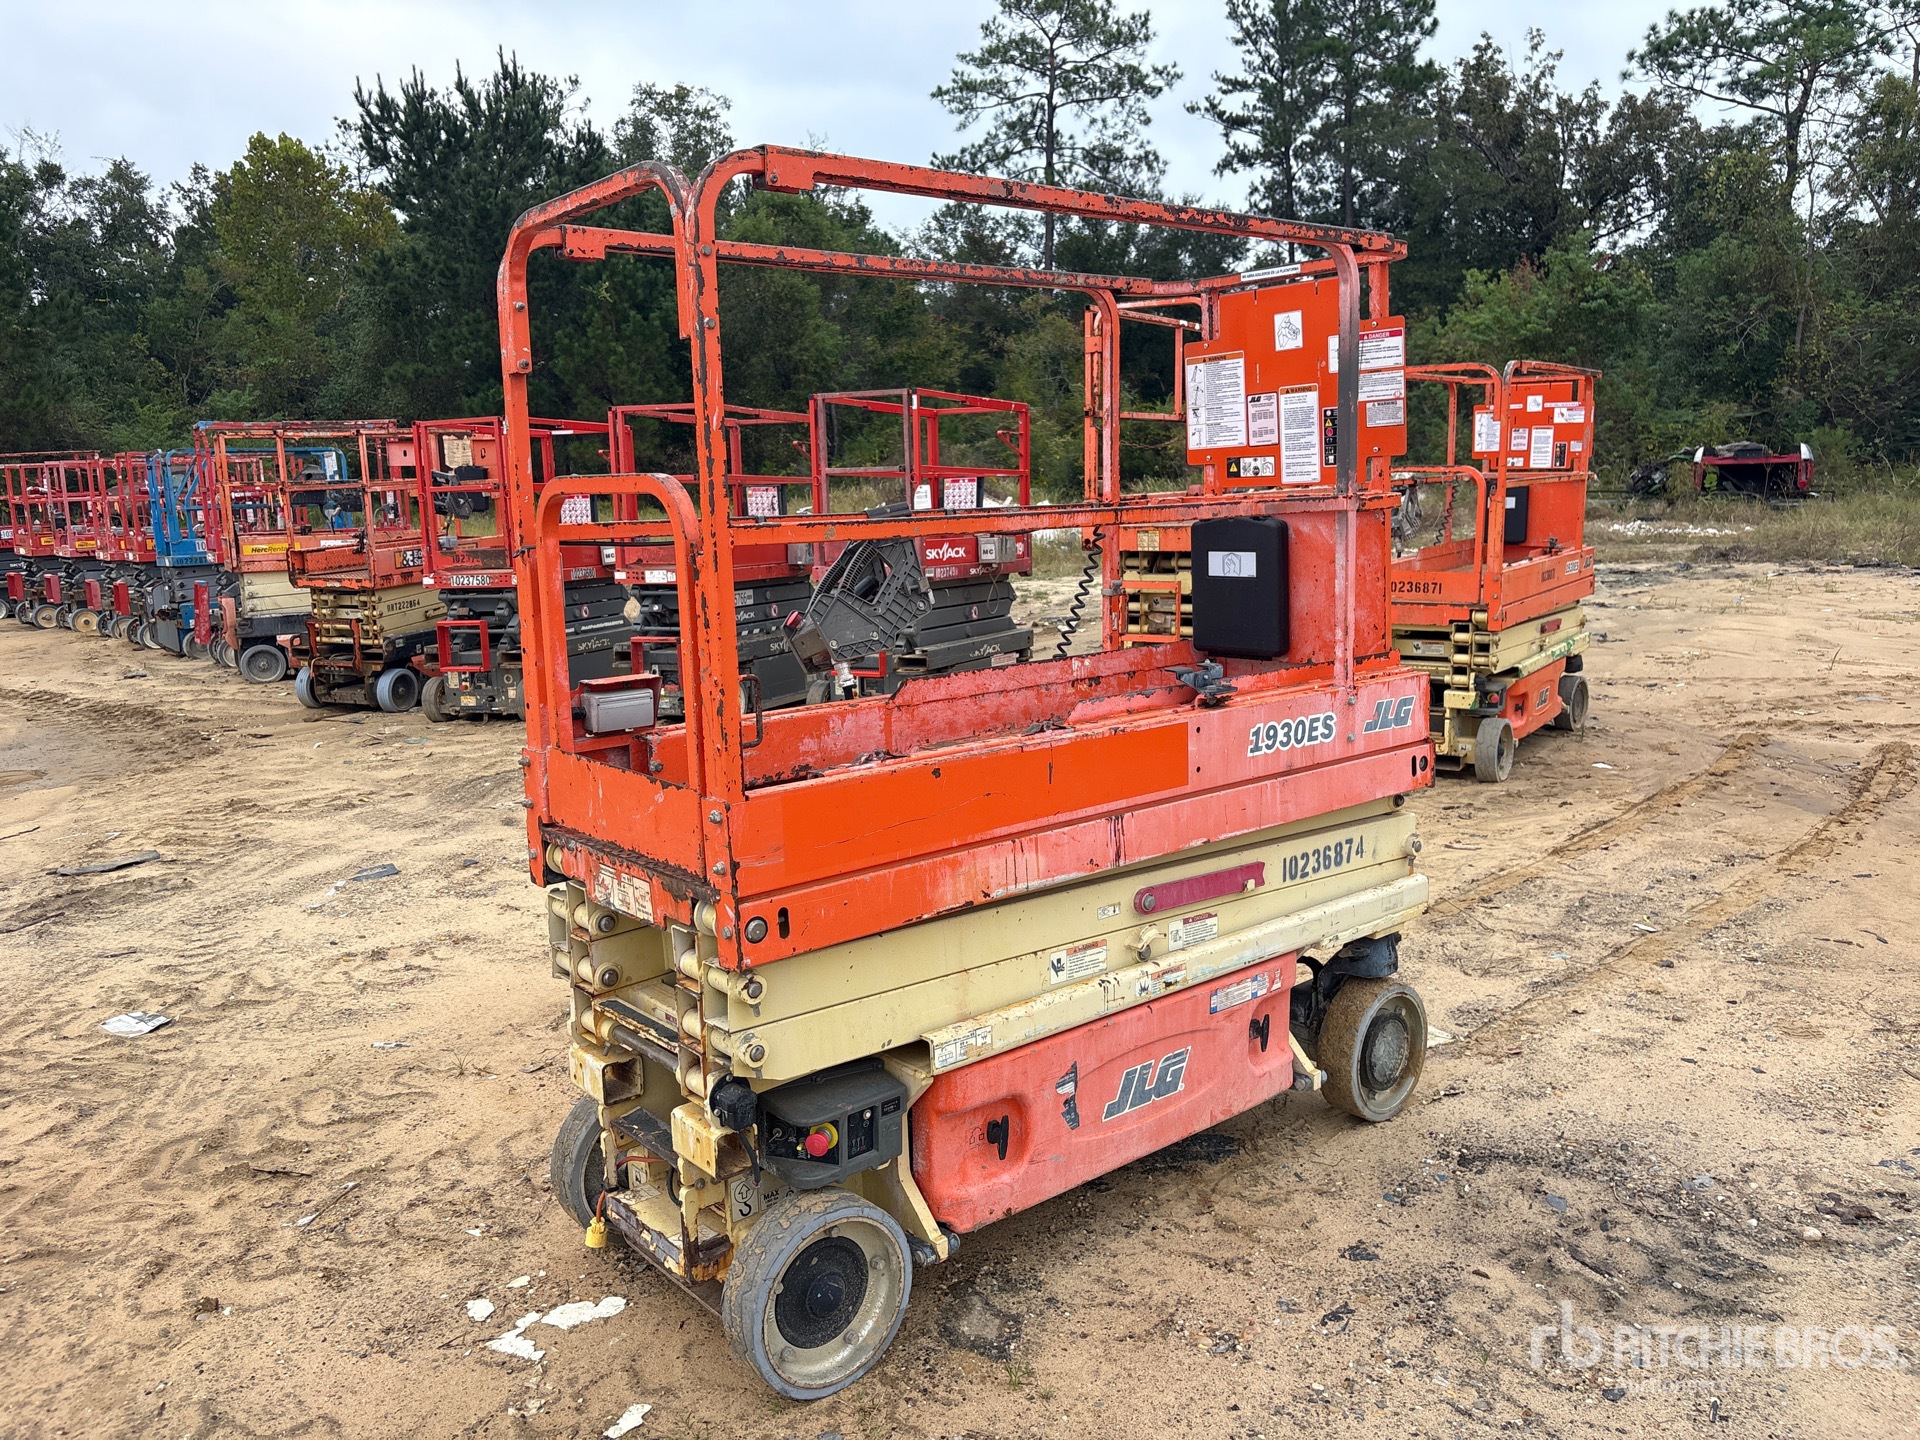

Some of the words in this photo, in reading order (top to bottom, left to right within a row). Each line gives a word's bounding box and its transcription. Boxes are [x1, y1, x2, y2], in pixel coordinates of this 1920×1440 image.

[926, 542, 966, 561] SKYJACK
[450, 575, 490, 587] 10237580
[1248, 711, 1337, 757] 1930ES
[1363, 696, 1416, 734] JLG
[1282, 834, 1364, 883] 10236874
[1102, 1046, 1191, 1121] JLG
[764, 1189, 779, 1201] MAX
